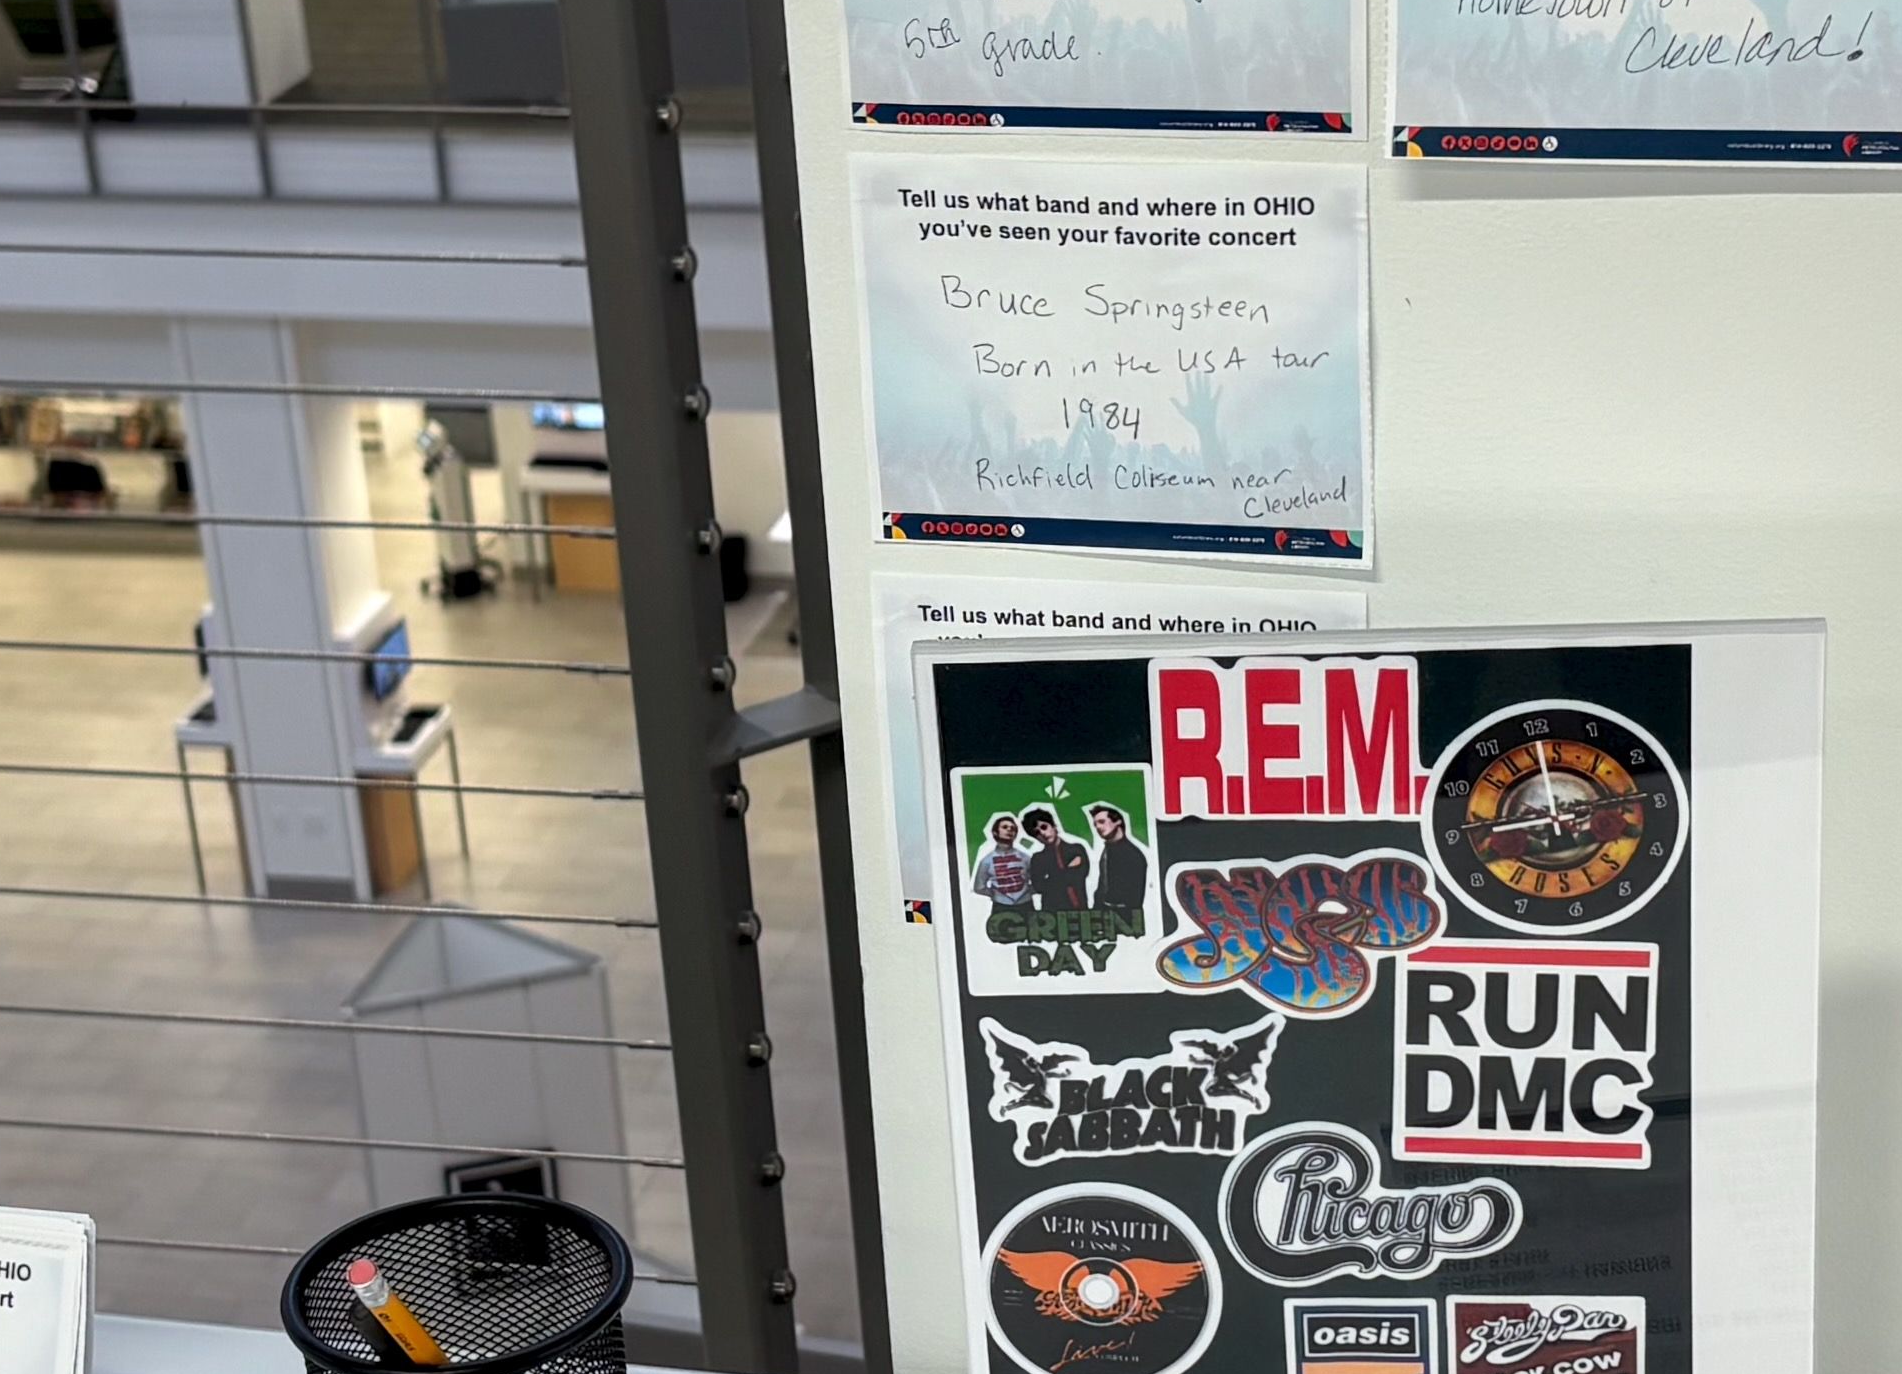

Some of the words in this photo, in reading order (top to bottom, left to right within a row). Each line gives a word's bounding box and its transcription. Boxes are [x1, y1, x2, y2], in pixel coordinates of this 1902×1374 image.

[940, 276, 1054, 319] Bruce
[1084, 285, 1269, 331] Springsteen
[974, 343, 1052, 377] Born
[1072, 361, 1097, 375] in
[1116, 353, 1161, 374] the
[1180, 347, 1247, 374] USA
[1272, 350, 1330, 370] tour
[1063, 398, 1141, 440] 1984
[985, 903, 1145, 946] GREEN
[1017, 941, 1119, 977] DAY
[1407, 970, 1650, 1050] RUN
[1059, 1065, 1206, 1114] BLACK
[1404, 1056, 1645, 1134] DMC
[1027, 1103, 1236, 1154] SABBATH
[1228, 1134, 1514, 1277] Chicago
[1312, 1321, 1412, 1347] oasis
